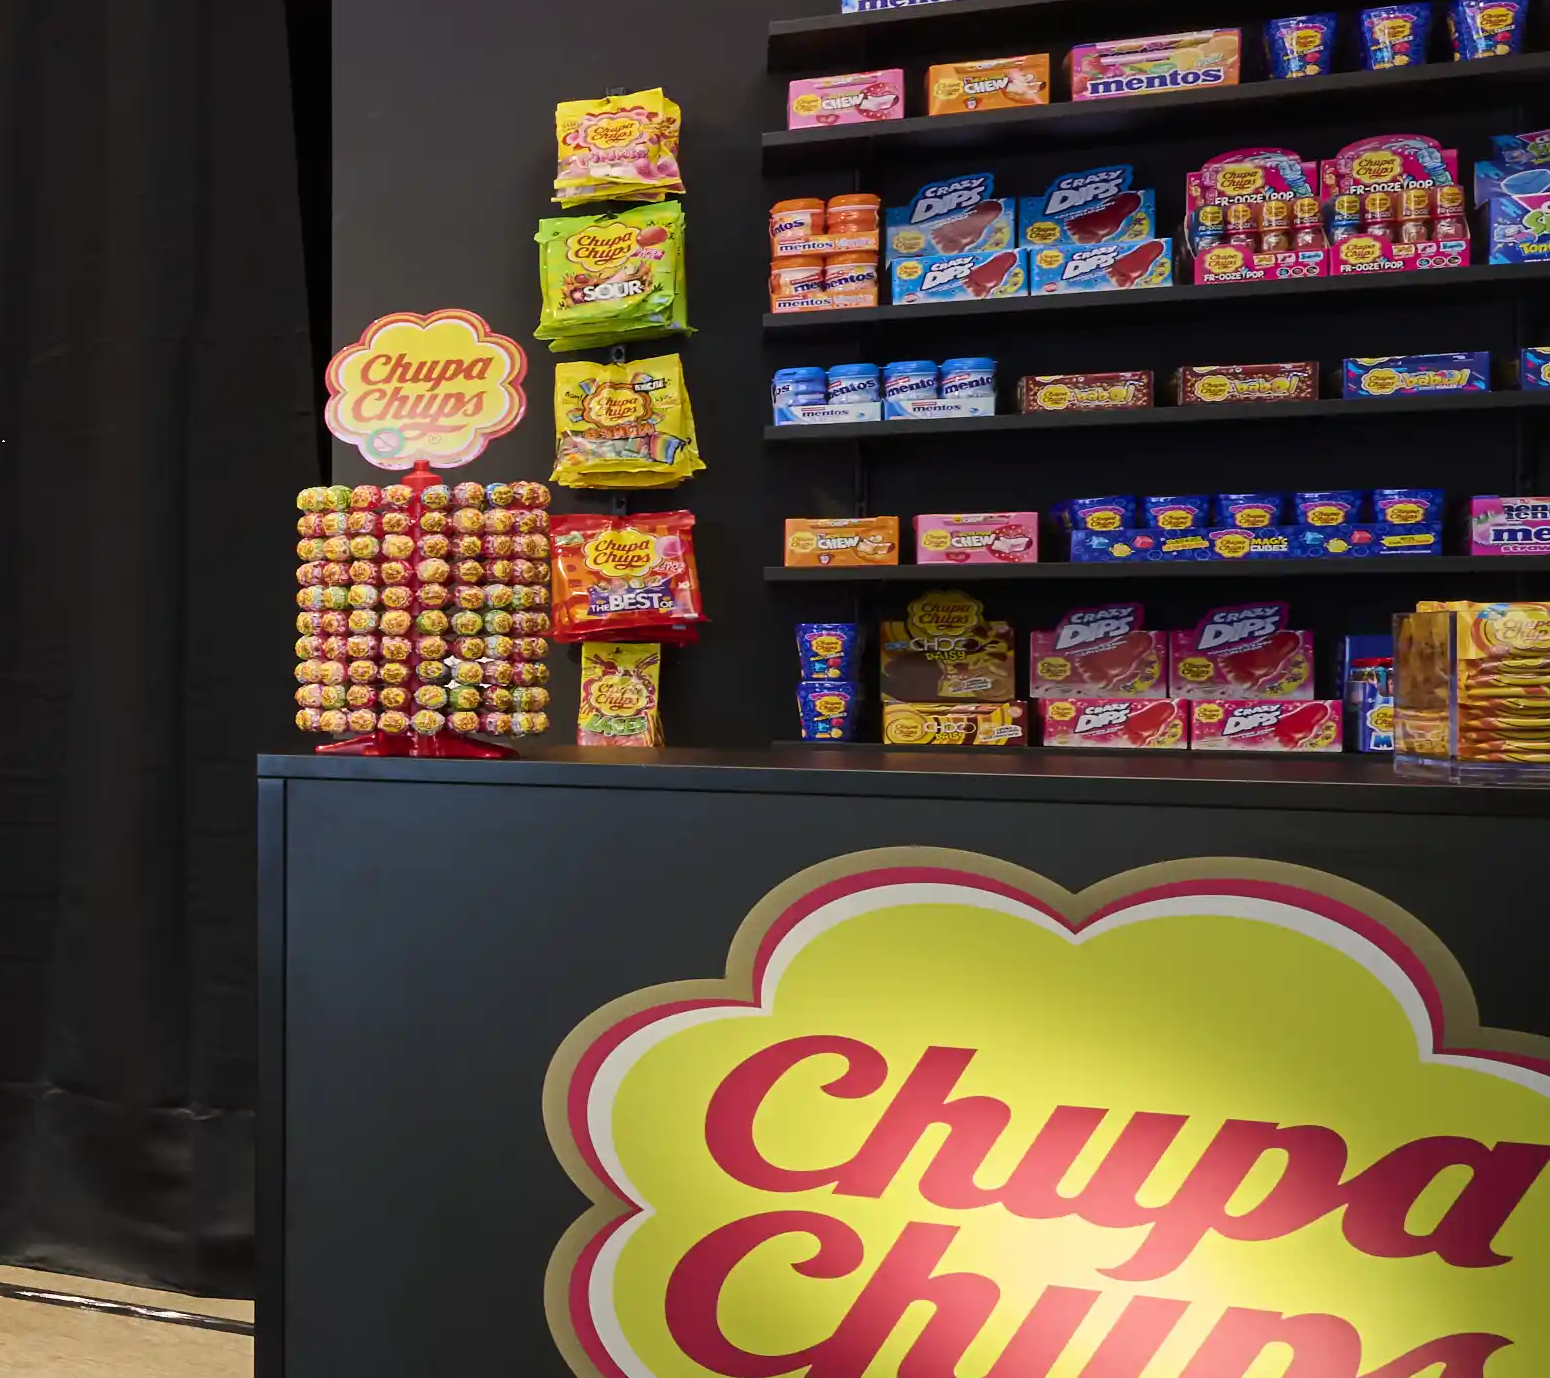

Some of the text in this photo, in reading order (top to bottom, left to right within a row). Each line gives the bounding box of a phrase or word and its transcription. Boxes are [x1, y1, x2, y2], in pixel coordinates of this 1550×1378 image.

[1088, 66, 1224, 96] mentos
[925, 176, 985, 197] CRAZY
[1061, 169, 1121, 189] CRAZY
[911, 186, 985, 223] DIPS
[1046, 178, 1124, 215] DIPS
[577, 231, 632, 248] Chupa
[779, 241, 833, 251] mentos
[575, 244, 631, 265] Chups
[930, 256, 972, 271] CRAZY
[1072, 246, 1114, 261] CRAZY
[921, 263, 972, 290] DIPS
[1062, 255, 1115, 280] DIPS
[584, 280, 643, 301] SOUR
[778, 297, 830, 308] mentos
[360, 353, 493, 391] Chupa
[351, 387, 486, 439] Chups
[801, 408, 848, 417] mentos
[912, 403, 961, 413] mentos
[595, 540, 649, 555] Chupa
[593, 552, 651, 570] Chups
[609, 592, 660, 611] BEST
[1071, 607, 1133, 623] CRAZY
[1213, 606, 1280, 623] CRAZY
[1057, 619, 1133, 650] DIPS
[1198, 614, 1279, 650] DIPS
[704, 1034, 1550, 1282] Chupa
